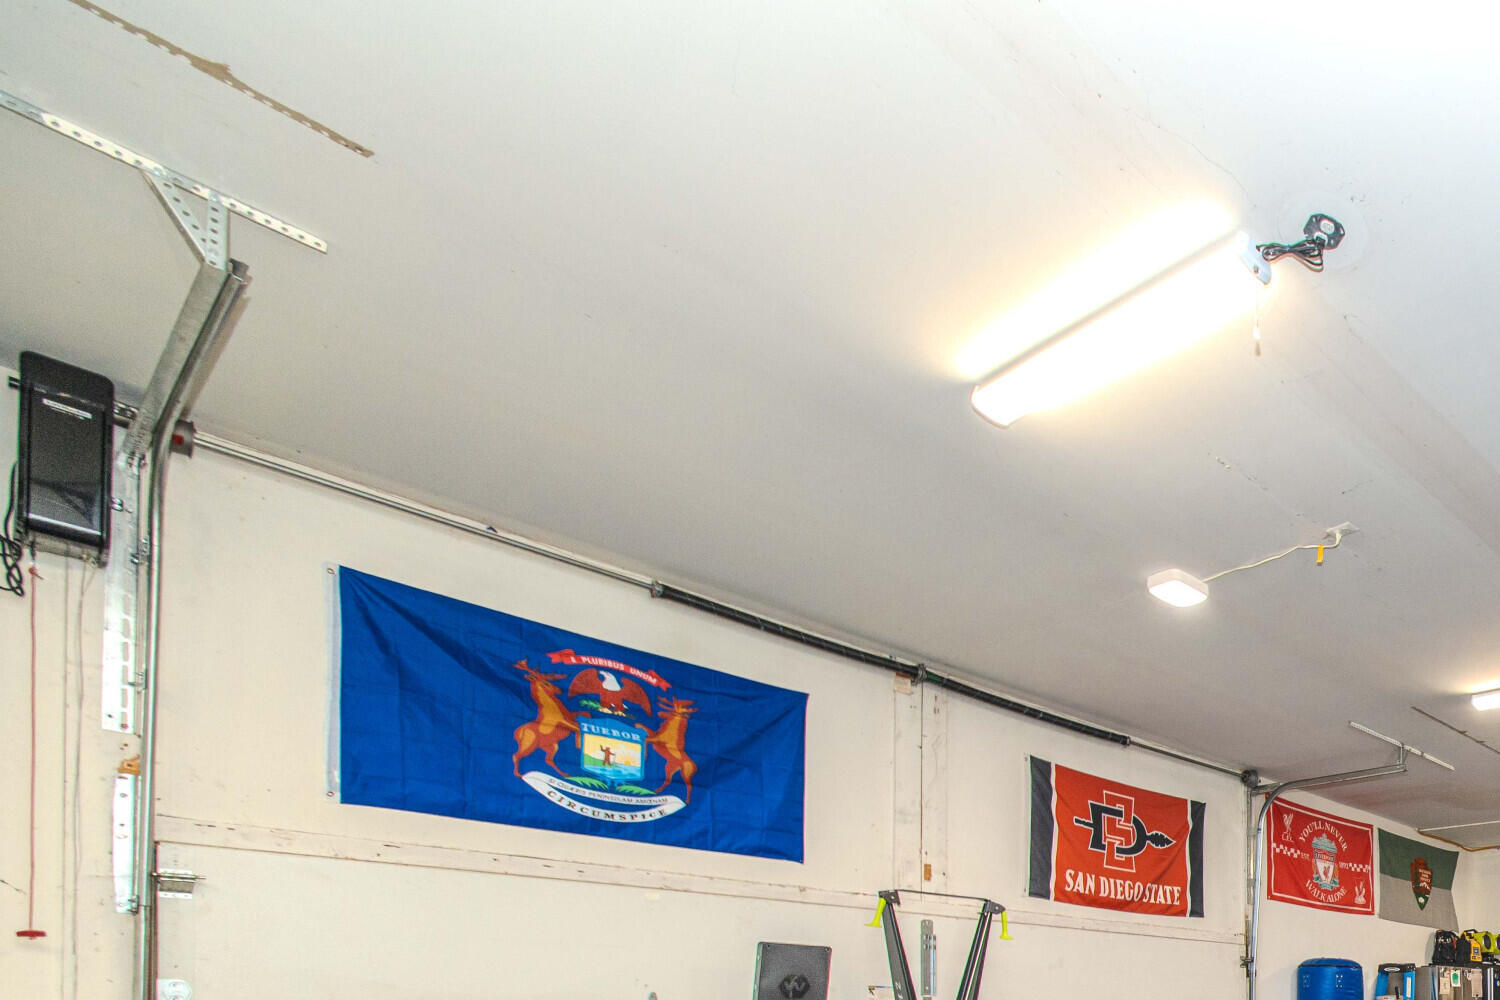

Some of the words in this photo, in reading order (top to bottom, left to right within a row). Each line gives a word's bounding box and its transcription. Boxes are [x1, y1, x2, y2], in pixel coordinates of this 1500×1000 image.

[581, 656, 625, 671] PLURIBUS
[629, 666, 657, 684] UNUM
[581, 722, 642, 741] TUEBOR
[547, 790, 667, 821] CIRCUMSPICE
[1325, 822, 1348, 852] NEVER
[1065, 869, 1096, 897] SAN
[1099, 875, 1144, 902] DIEGO
[1143, 882, 1182, 906] STATE
[1305, 880, 1326, 901] WALK
[1327, 886, 1347, 903] ALONE
